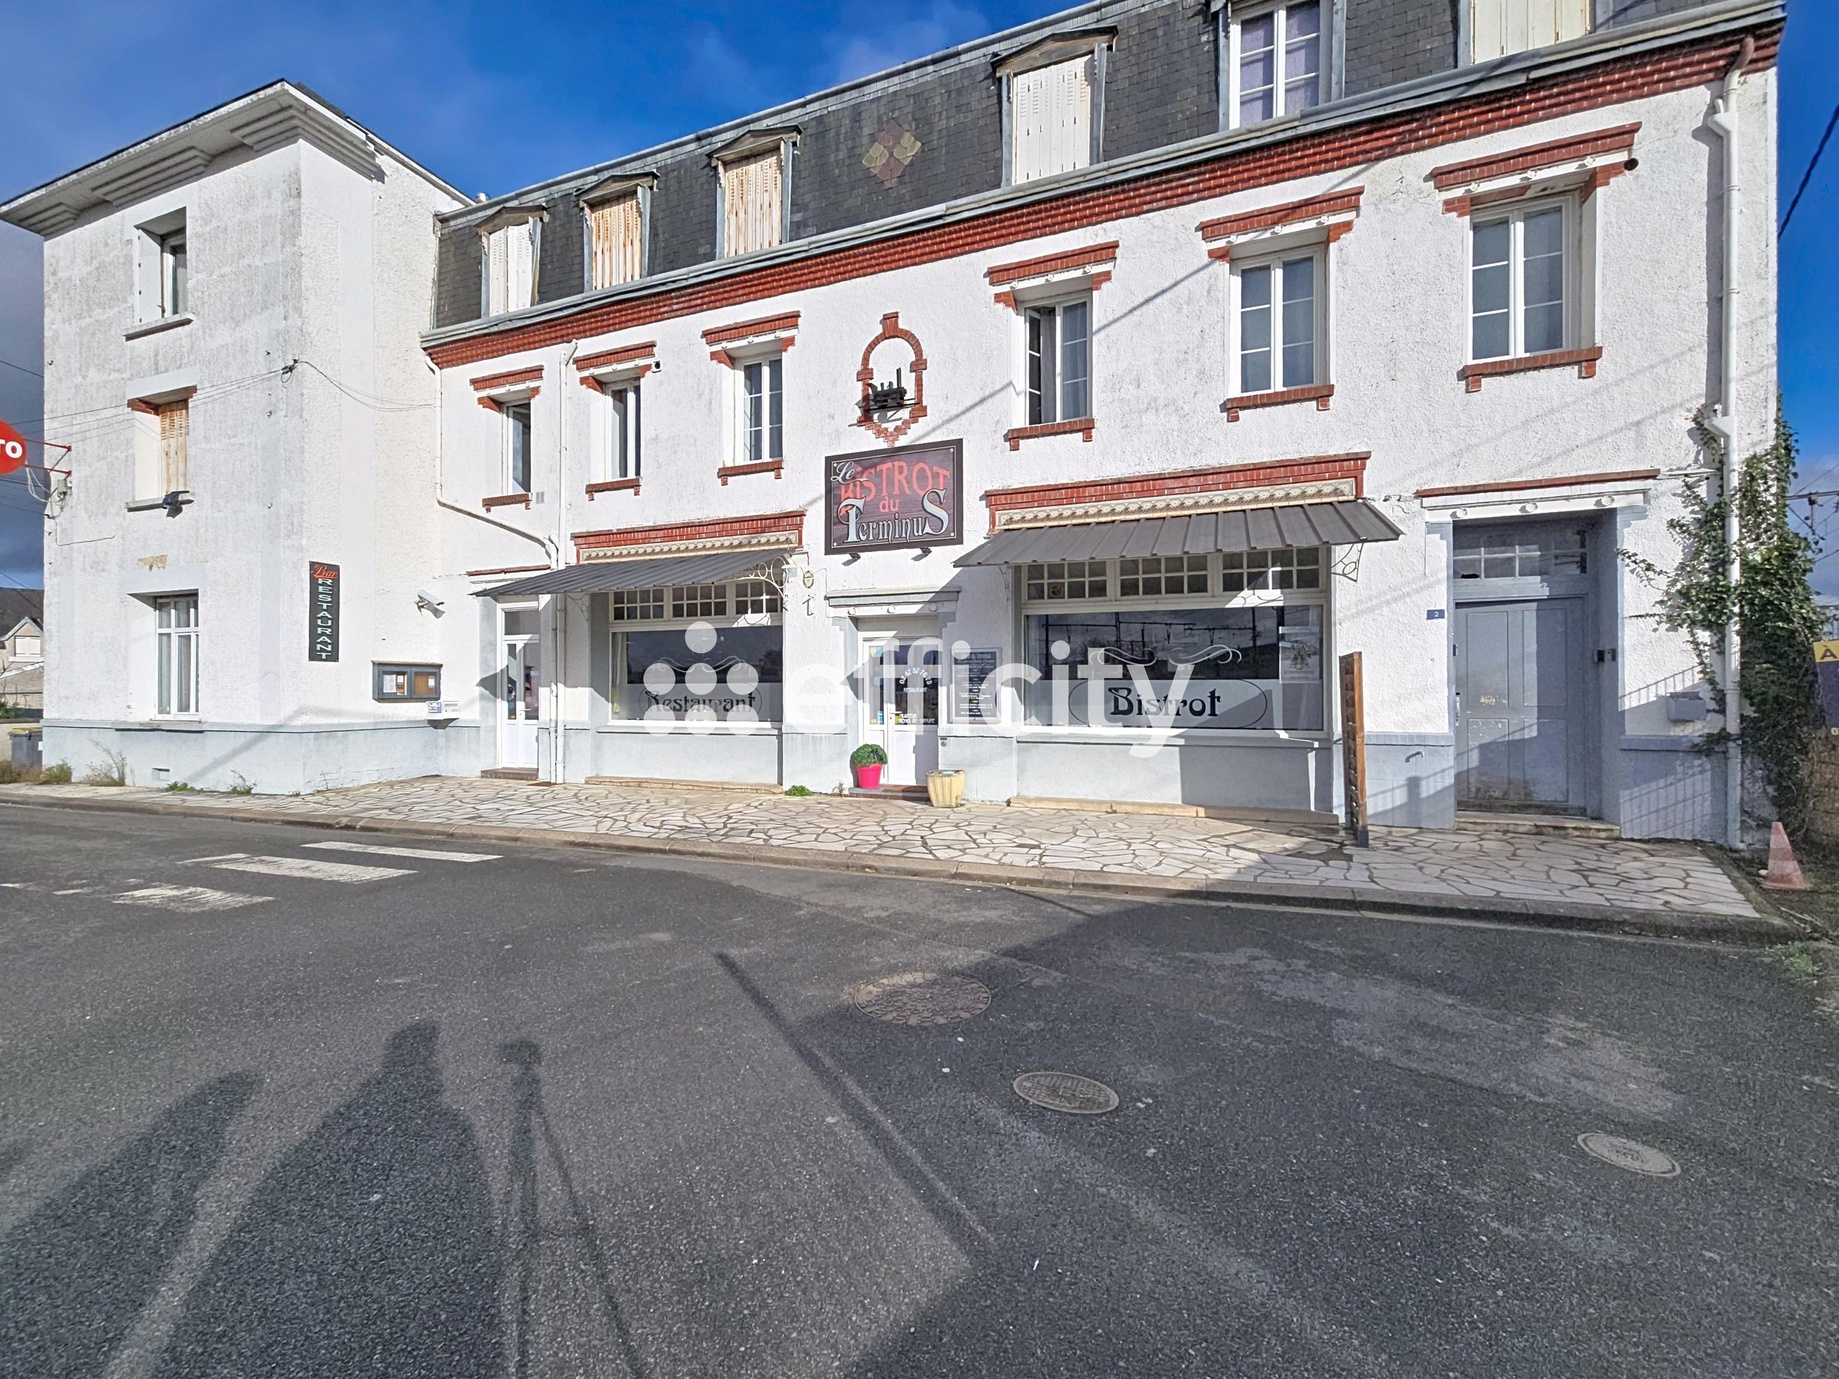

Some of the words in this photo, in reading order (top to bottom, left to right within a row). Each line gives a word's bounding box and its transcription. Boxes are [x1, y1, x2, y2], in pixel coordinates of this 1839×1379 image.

[831, 461, 868, 485] Le
[879, 494, 900, 513] du
[313, 564, 338, 579] Bar
[316, 578, 333, 660] RESTAURANT
[645, 690, 755, 713] Restaurant
[1108, 687, 1221, 717] Bistrot
